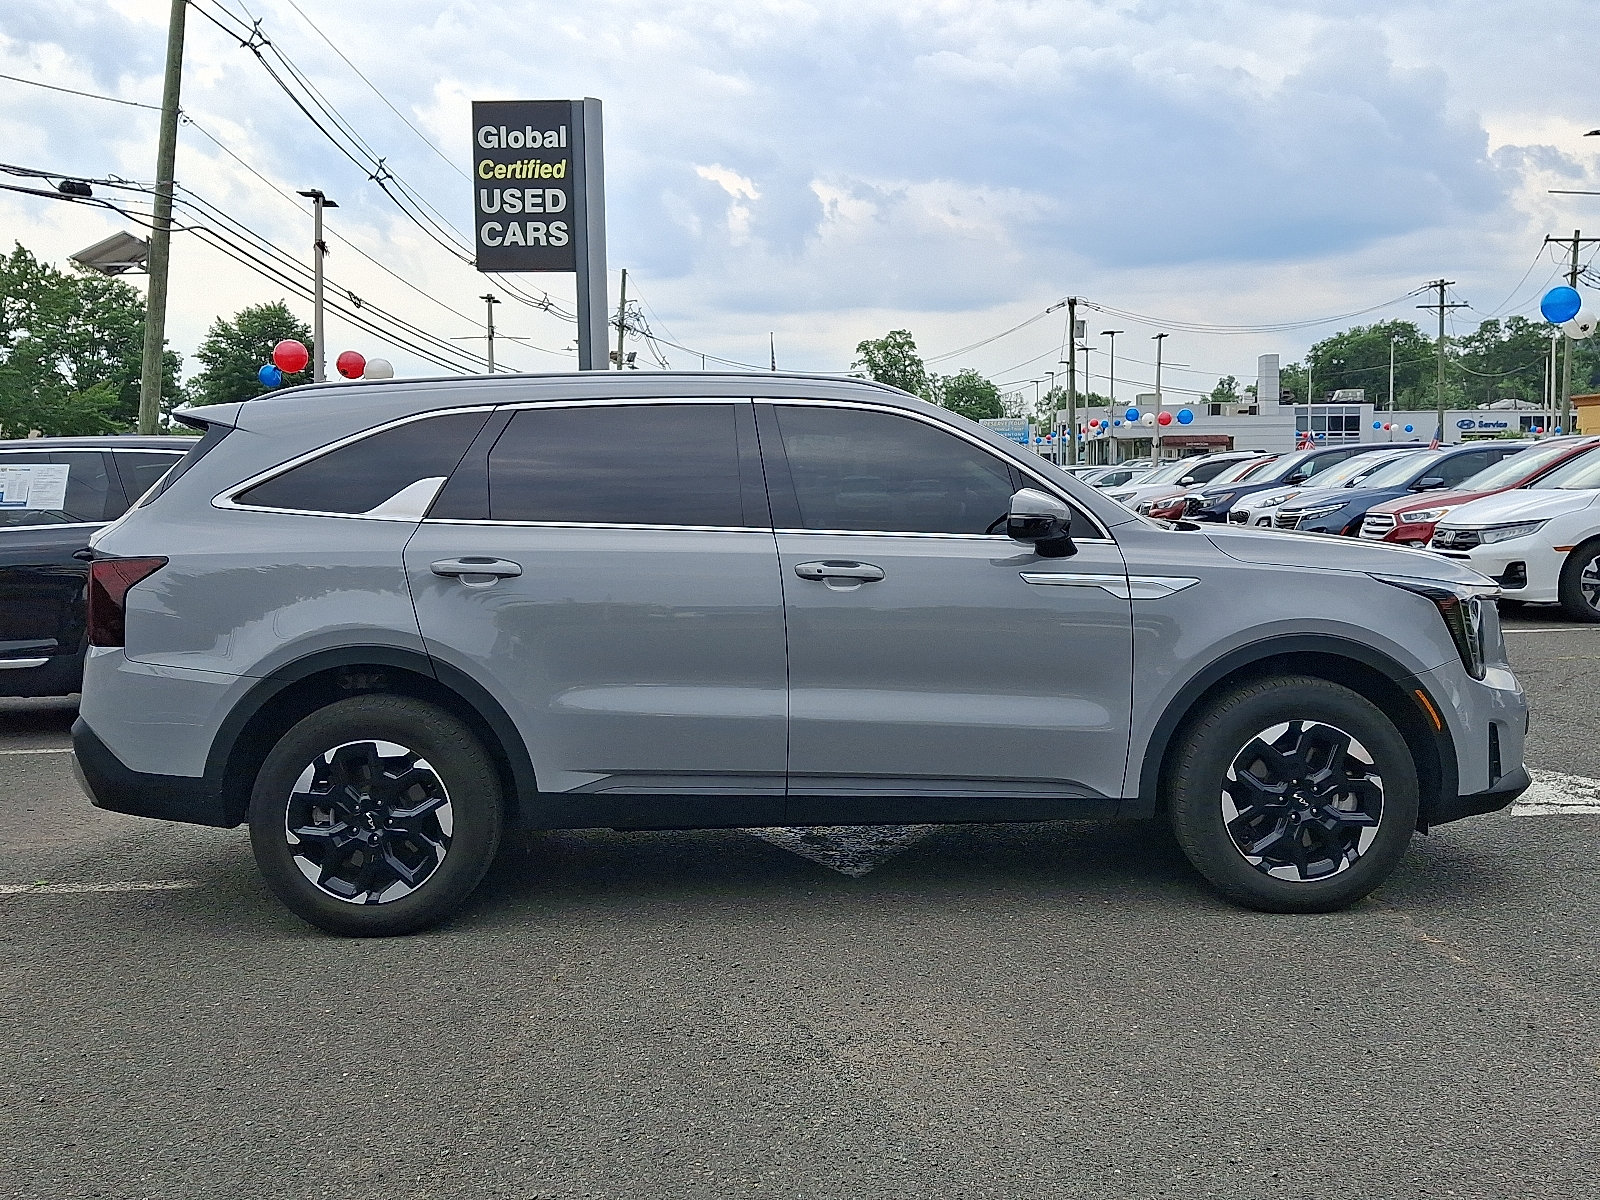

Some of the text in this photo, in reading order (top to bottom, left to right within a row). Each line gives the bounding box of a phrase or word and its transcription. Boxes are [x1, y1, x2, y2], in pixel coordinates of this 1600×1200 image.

[477, 125, 567, 149] Global
[478, 159, 567, 179] Certified
[480, 188, 567, 214] USED
[480, 221, 569, 247] CARS
